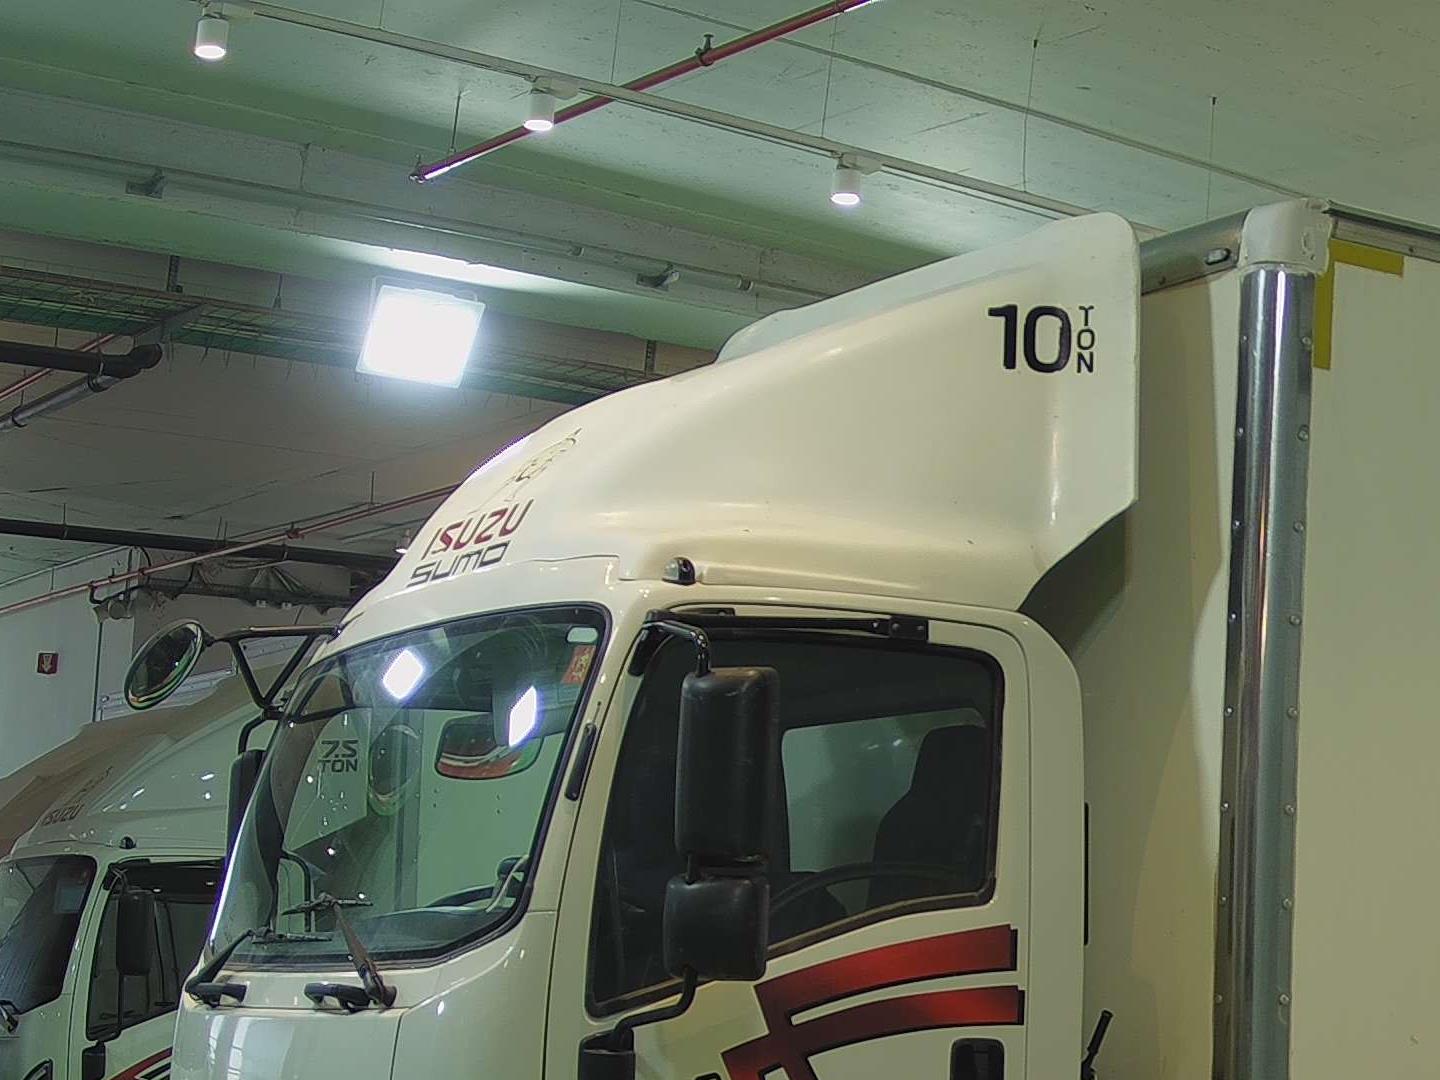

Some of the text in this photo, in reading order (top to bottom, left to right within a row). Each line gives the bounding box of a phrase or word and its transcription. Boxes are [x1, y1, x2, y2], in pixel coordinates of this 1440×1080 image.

[988, 304, 1095, 373] 10 TON
[421, 499, 534, 560] ISUZU
[406, 540, 511, 588] SUMO
[317, 758, 358, 773] TON
